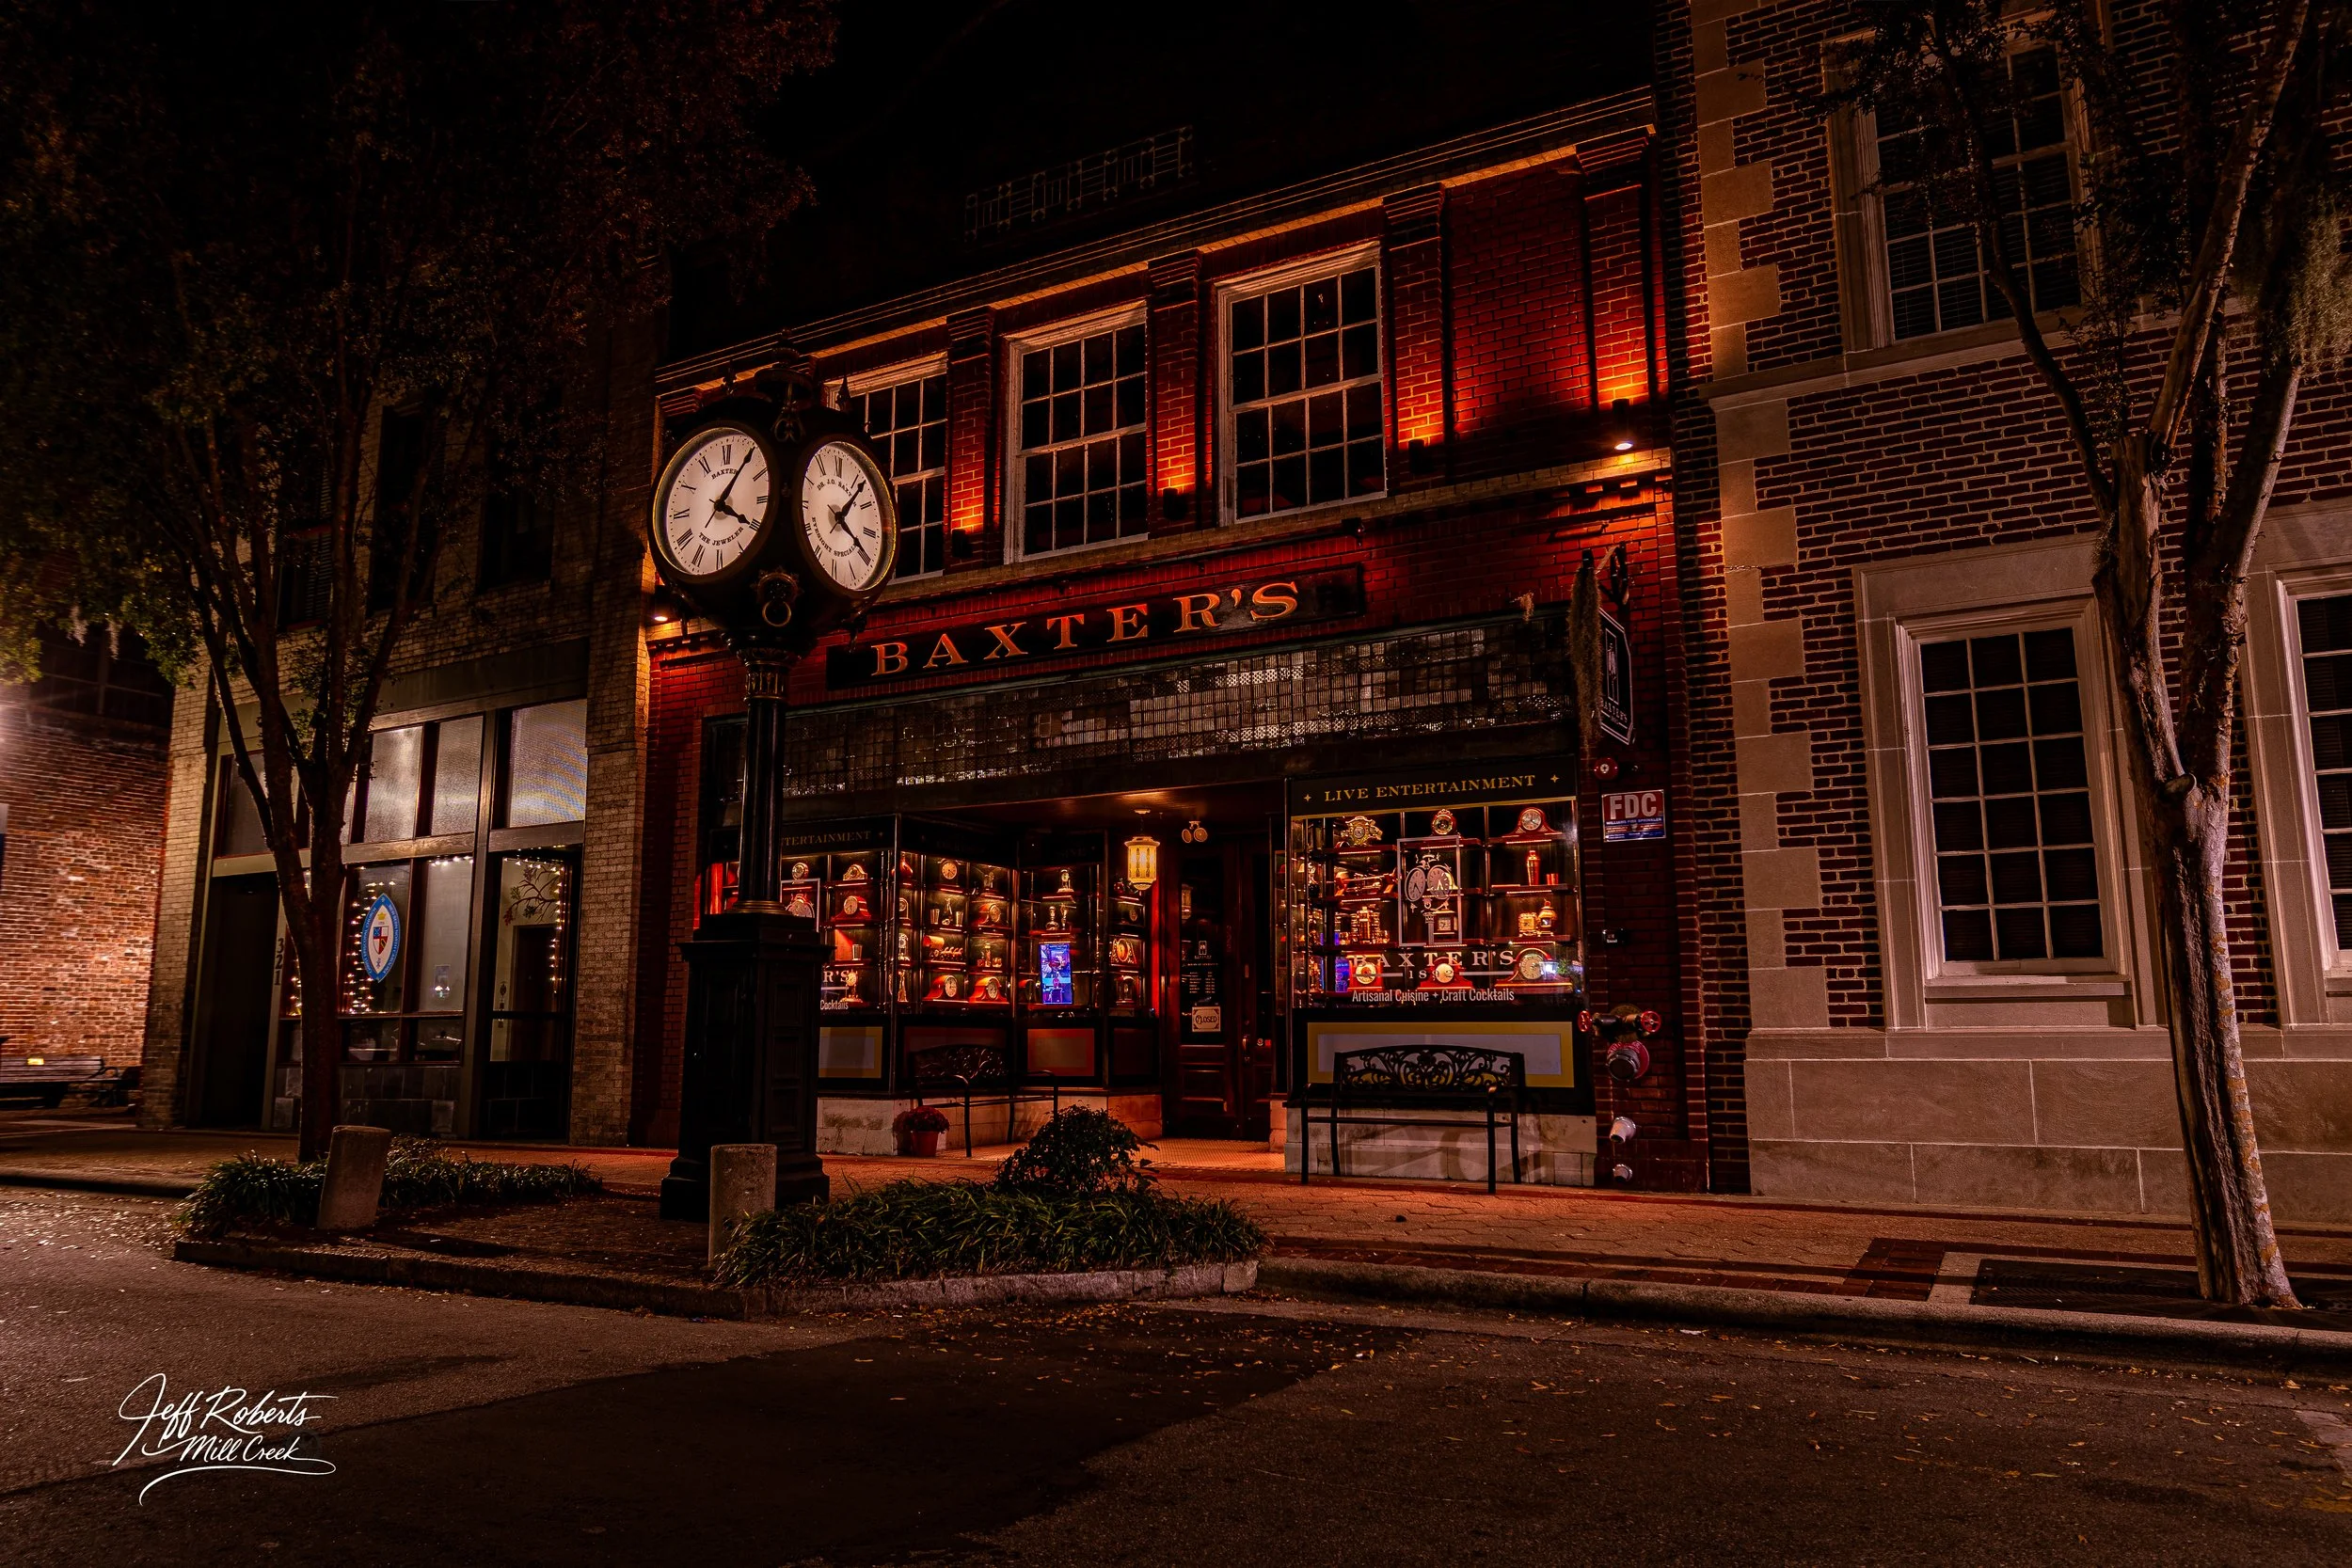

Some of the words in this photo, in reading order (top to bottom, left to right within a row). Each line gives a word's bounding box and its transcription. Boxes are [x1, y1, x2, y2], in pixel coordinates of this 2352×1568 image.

[837, 481, 857, 508] BAXTR
[698, 531, 710, 545] THE
[712, 526, 744, 546] JEWELER
[871, 580, 1299, 677] BAXTER'S
[1324, 787, 1369, 802] LIVE
[1376, 774, 1536, 799] ENTERTAINMENT
[1610, 793, 1658, 820] FDC
[274, 937, 284, 986] 321
[1352, 950, 1515, 968] BAXTER'S
[1352, 990, 1392, 1003] Artisanal
[1395, 990, 1429, 1003] Cuisine
[1441, 989, 1468, 1002] Craft
[1469, 989, 1515, 1002] Cocktails
[1195, 1014, 1217, 1025] CLOSED
